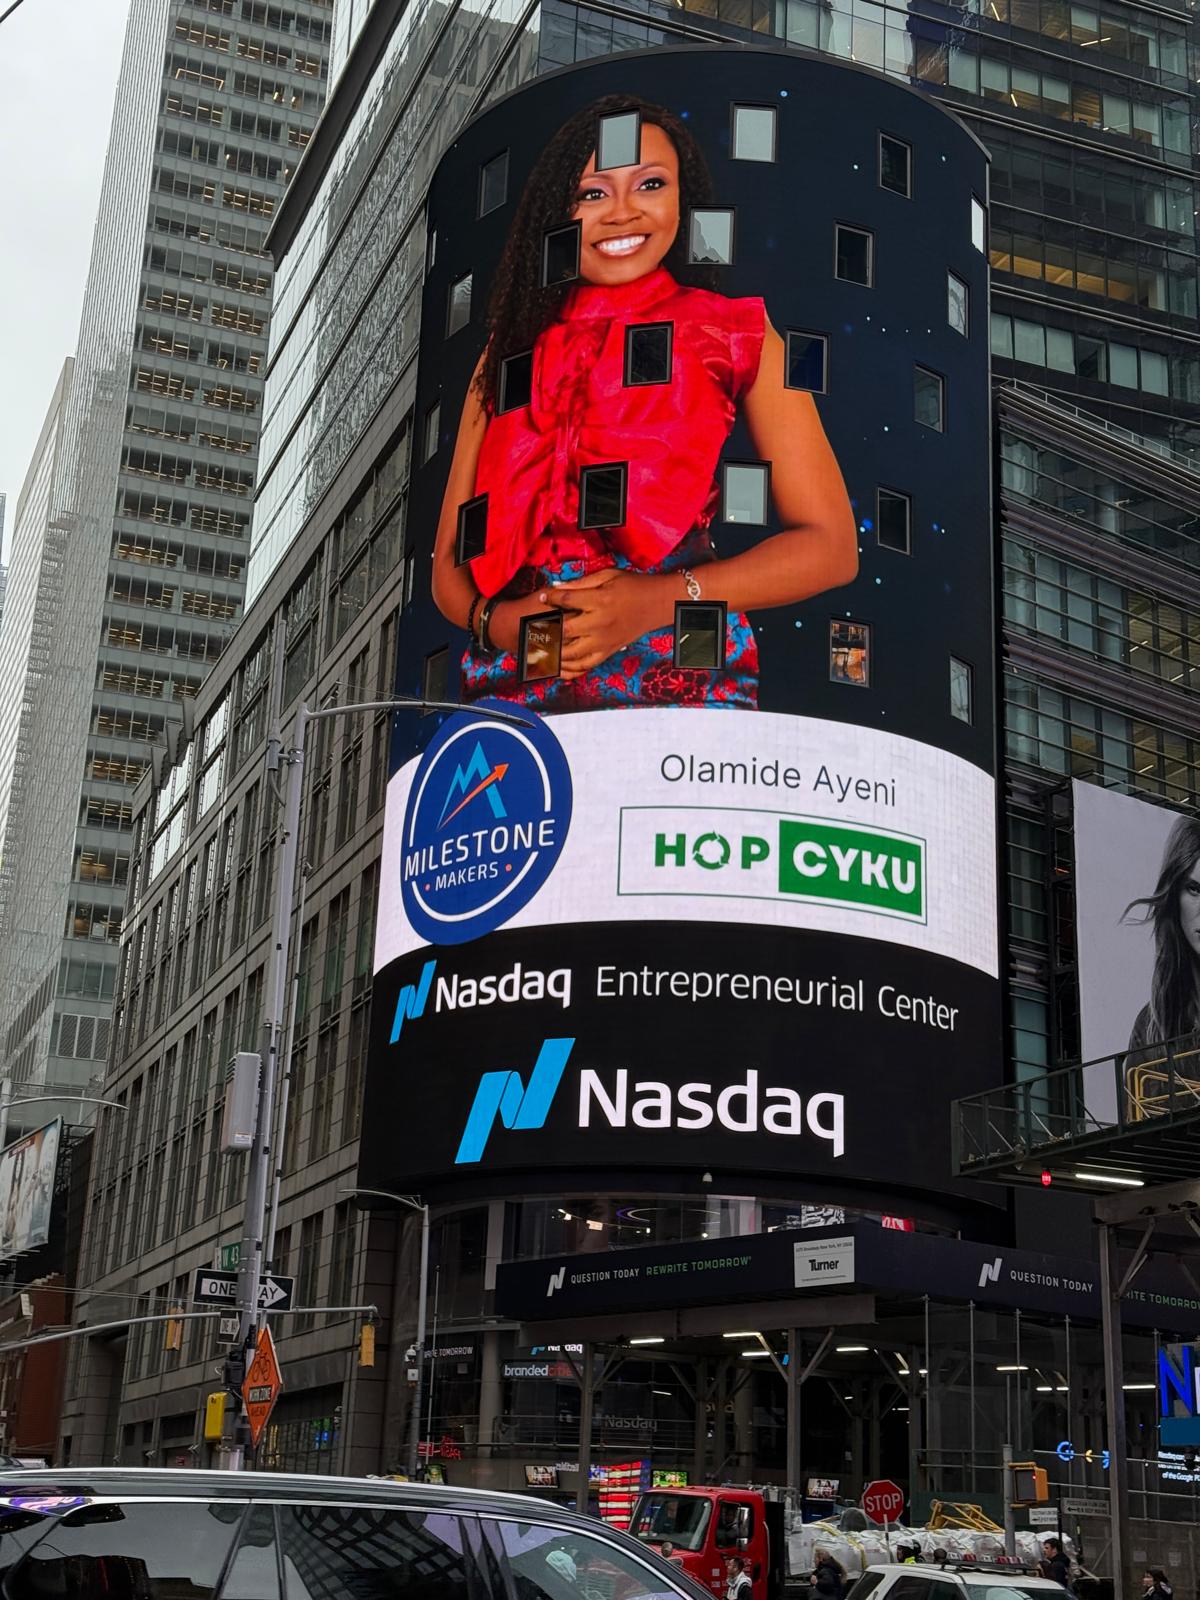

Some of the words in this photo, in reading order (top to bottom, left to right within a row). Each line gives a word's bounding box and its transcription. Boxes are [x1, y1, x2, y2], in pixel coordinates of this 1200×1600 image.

[661, 753, 800, 788] Olamide
[813, 764, 896, 807] Ayeni
[404, 818, 555, 882] MILESTONE
[435, 861, 499, 892] MAKERS
[793, 840, 917, 896] CYKU
[435, 963, 572, 1013] Nasdaq
[597, 966, 863, 1012] Entrepreneurial
[878, 986, 959, 1031] Center
[579, 1069, 845, 1158] Nasdaq
[570, 1271, 610, 1285] QUESTION
[613, 1268, 640, 1279] TODAY
[646, 1262, 688, 1276] REWRITE
[808, 1259, 839, 1272] Turner
[209, 1282, 238, 1296] ONE
[258, 1285, 278, 1300] AY
[1010, 1270, 1059, 1288] QUESTION
[1062, 1278, 1093, 1293] TODAY
[865, 1493, 901, 1513] STOP
